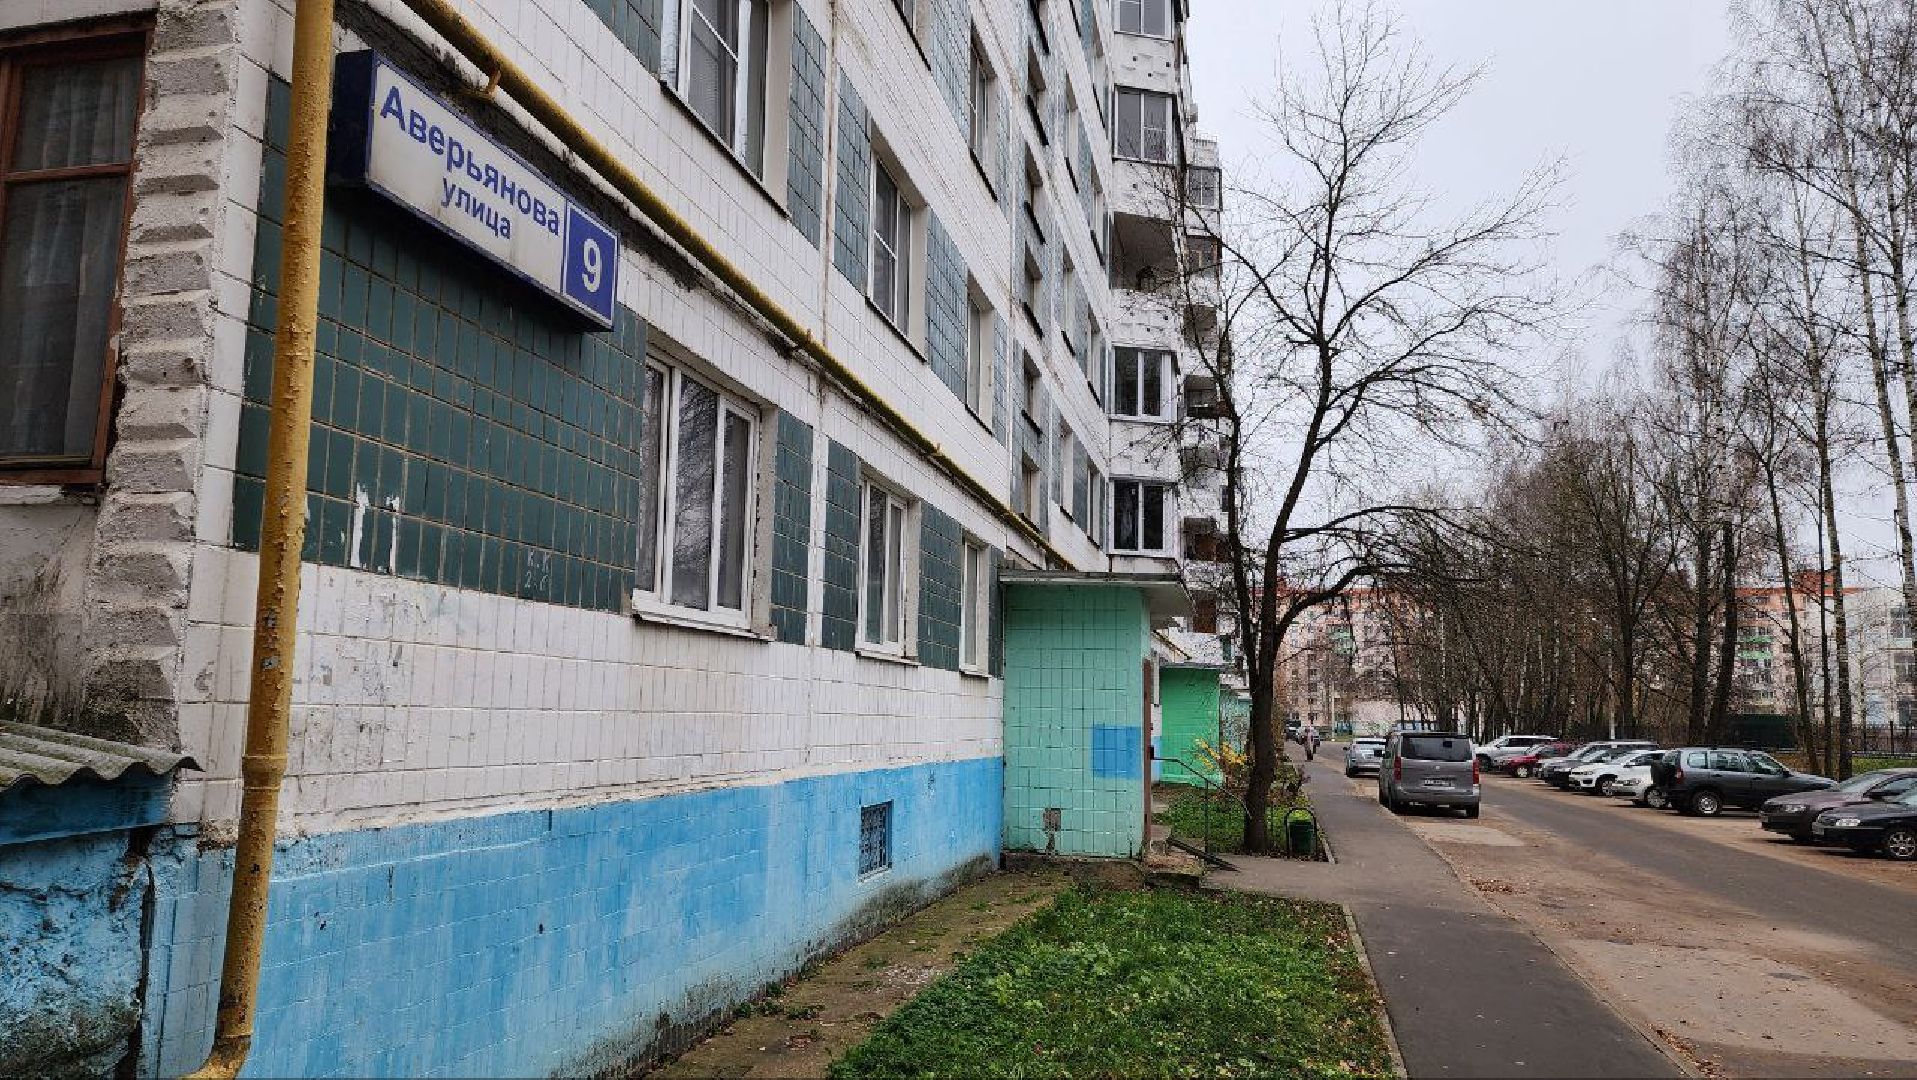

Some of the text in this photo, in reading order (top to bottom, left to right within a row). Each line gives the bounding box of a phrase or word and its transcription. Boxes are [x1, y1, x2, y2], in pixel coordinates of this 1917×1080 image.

[380, 85, 560, 236] Аверьянова
[440, 177, 511, 239] улица
[582, 238, 601, 293] 9
